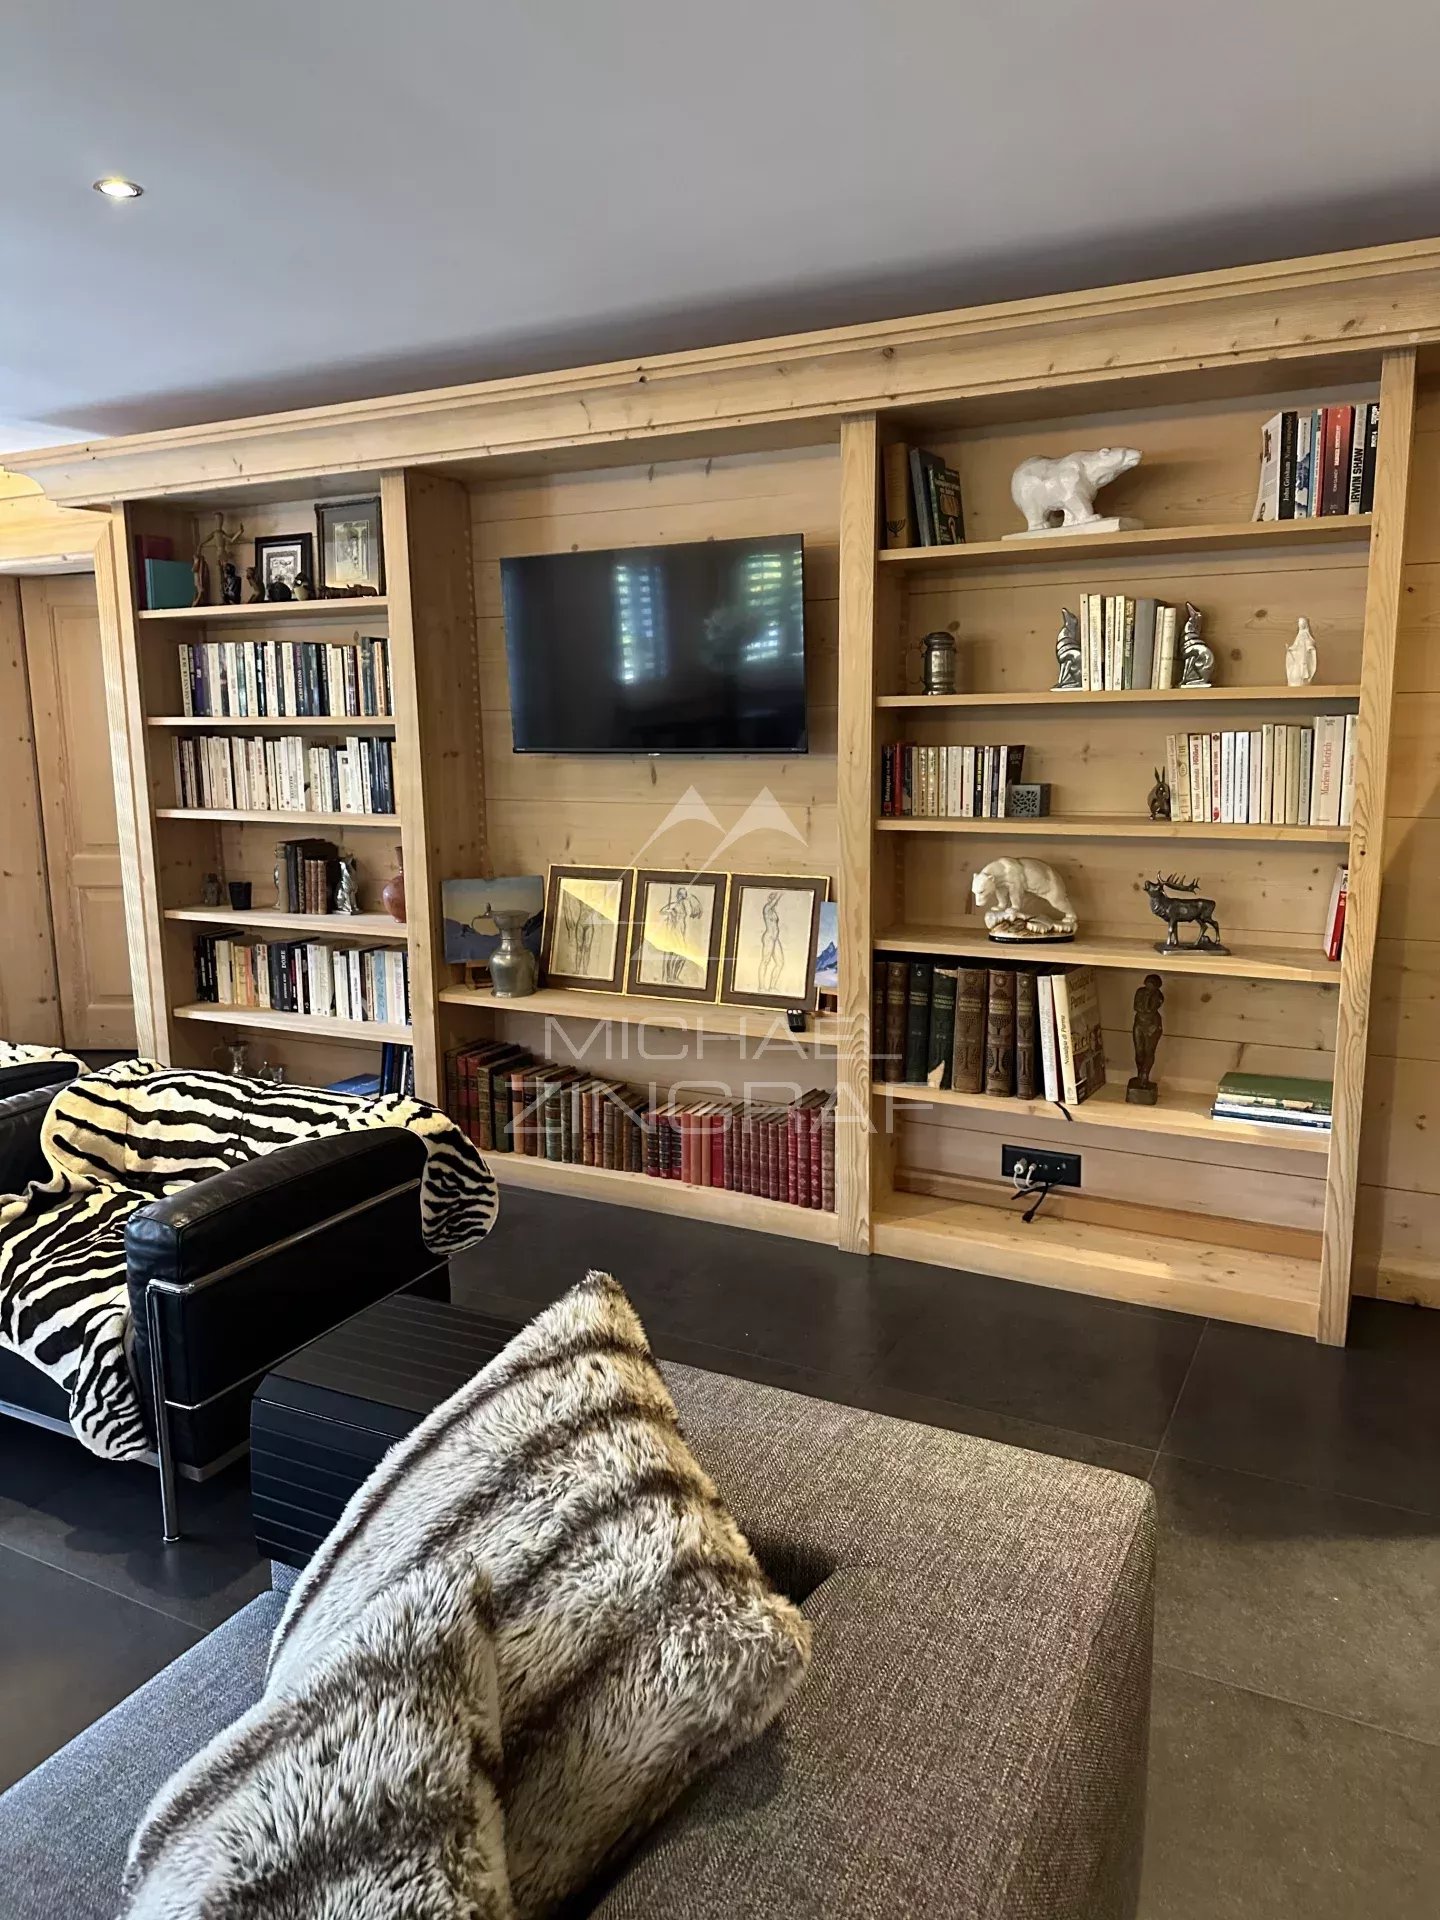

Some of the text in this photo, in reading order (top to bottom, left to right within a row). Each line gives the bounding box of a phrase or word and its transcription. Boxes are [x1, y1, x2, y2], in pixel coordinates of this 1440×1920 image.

[1350, 448, 1363, 503] IRWIN SHAW
[1320, 742, 1332, 795] Marlene Dietrich
